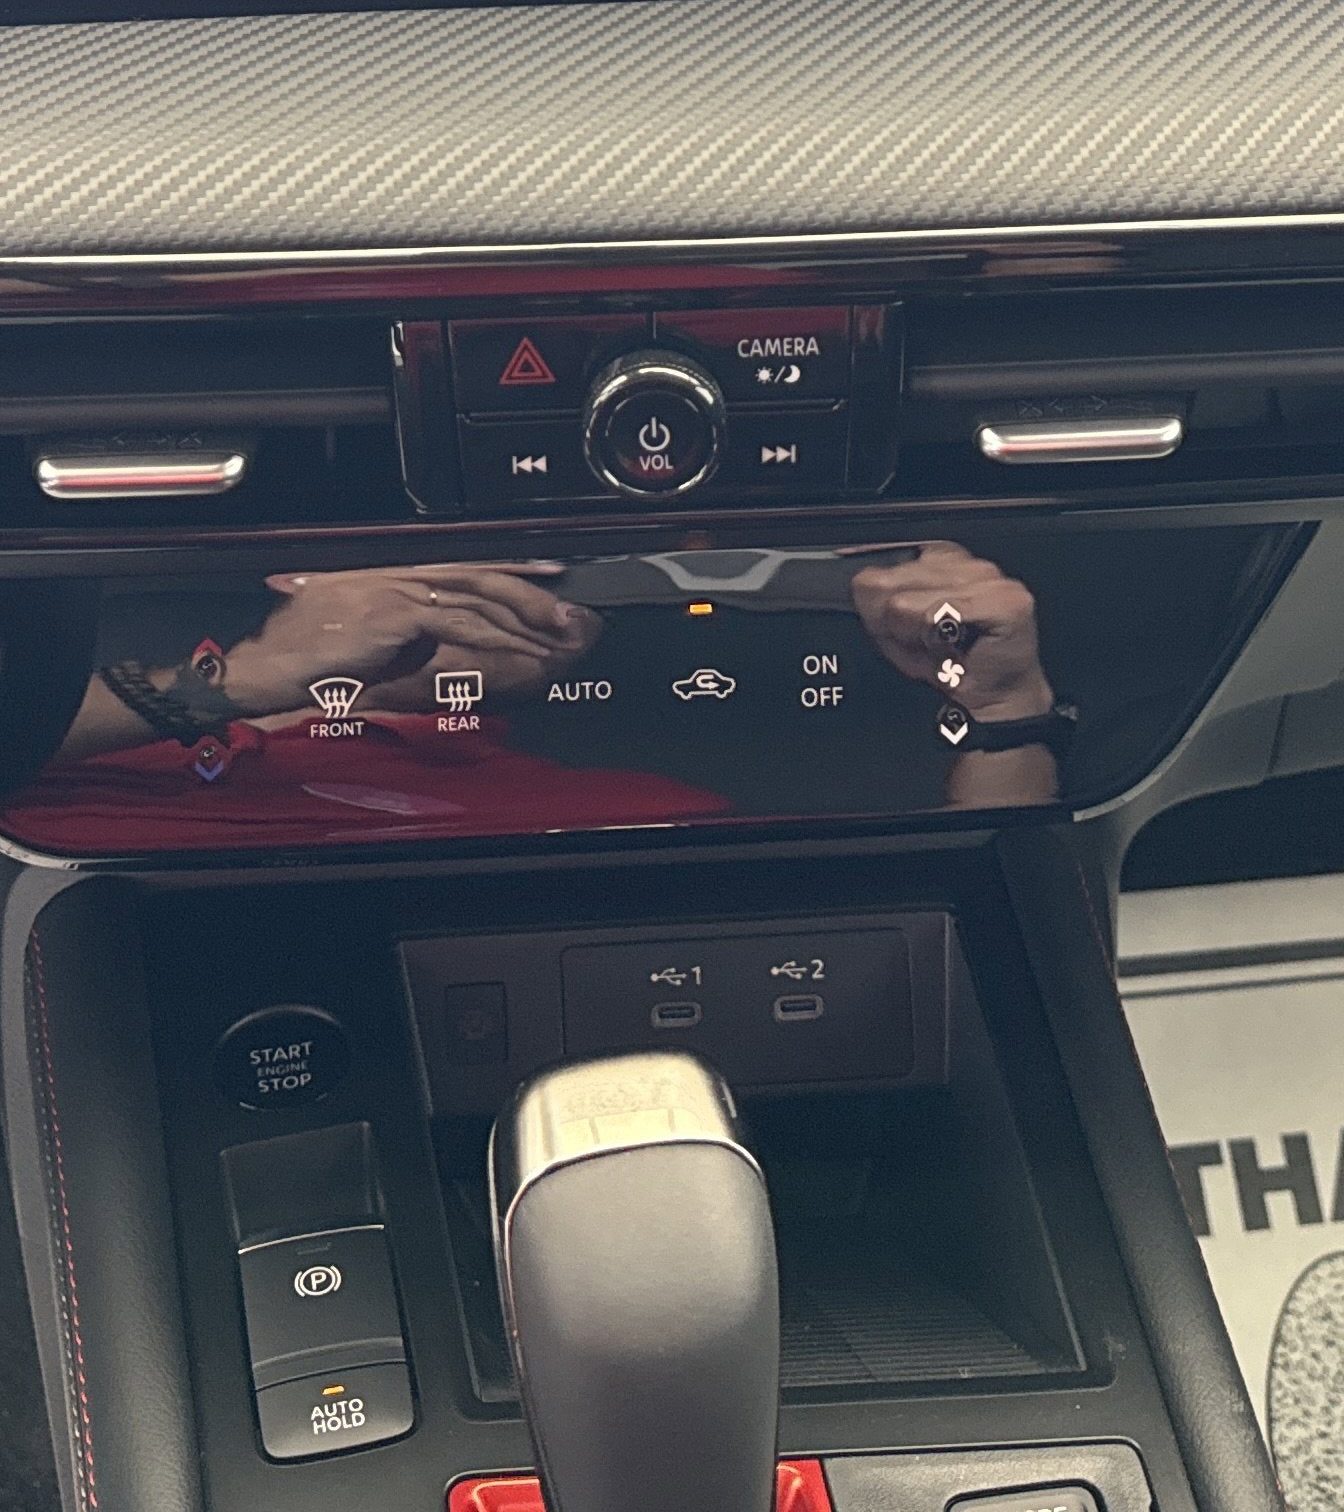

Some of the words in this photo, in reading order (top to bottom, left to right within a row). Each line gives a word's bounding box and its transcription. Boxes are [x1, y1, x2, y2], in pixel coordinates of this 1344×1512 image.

[737, 336, 821, 360] CAMERA
[639, 455, 674, 471] VOL
[802, 654, 838, 676] ON
[547, 680, 613, 702] AUTO
[800, 686, 844, 708] OFF
[309, 721, 365, 738] FRONT
[437, 715, 481, 733] REAR
[691, 965, 702, 986] 1
[810, 959, 825, 980] 2
[249, 1041, 313, 1065] START
[257, 1059, 309, 1077] ENGINE
[258, 1072, 312, 1094] STOP
[311, 1398, 364, 1421] AUTO
[313, 1412, 366, 1436] HOLD
